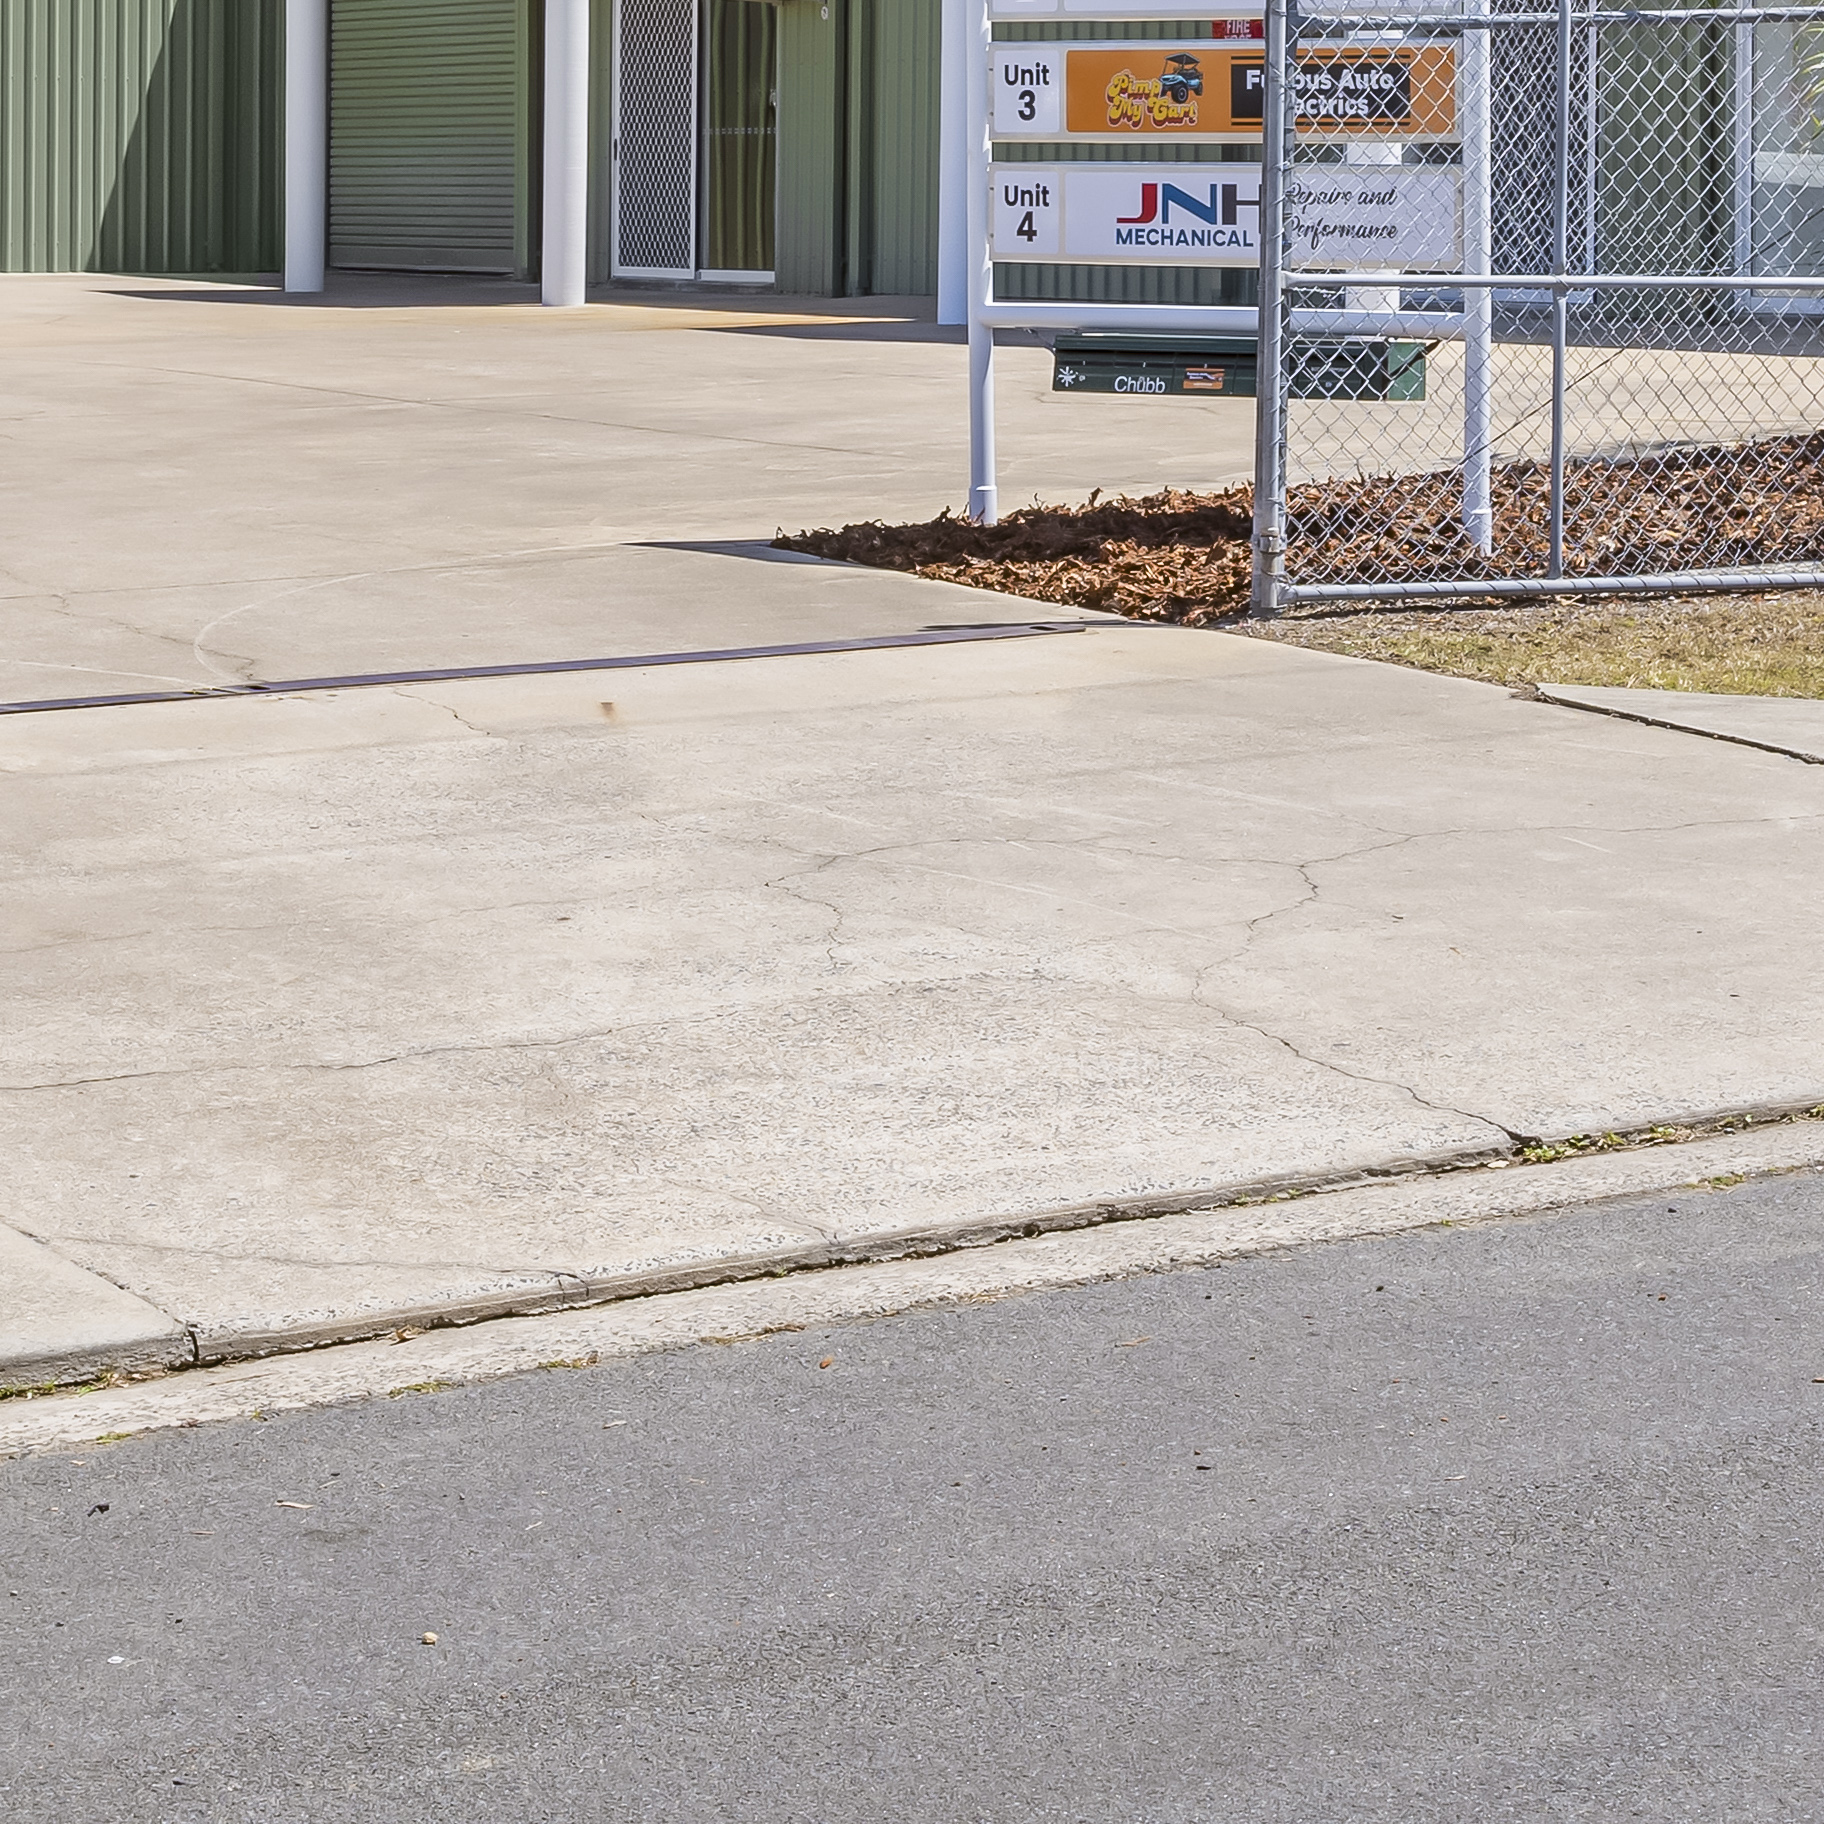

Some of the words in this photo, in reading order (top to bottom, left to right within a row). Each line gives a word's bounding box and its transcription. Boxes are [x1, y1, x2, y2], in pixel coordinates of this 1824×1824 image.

[1004, 62, 1050, 86] Unit
[1339, 69, 1394, 90] Auto
[1106, 70, 1161, 103] Pimp
[1017, 90, 1036, 121] 3
[1108, 96, 1143, 129] My
[1004, 183, 1050, 207] Unit
[1357, 186, 1398, 206] and
[1016, 211, 1037, 242] 4
[1115, 228, 1254, 247] MECHANICAL
[1114, 375, 1166, 394] Chubb
